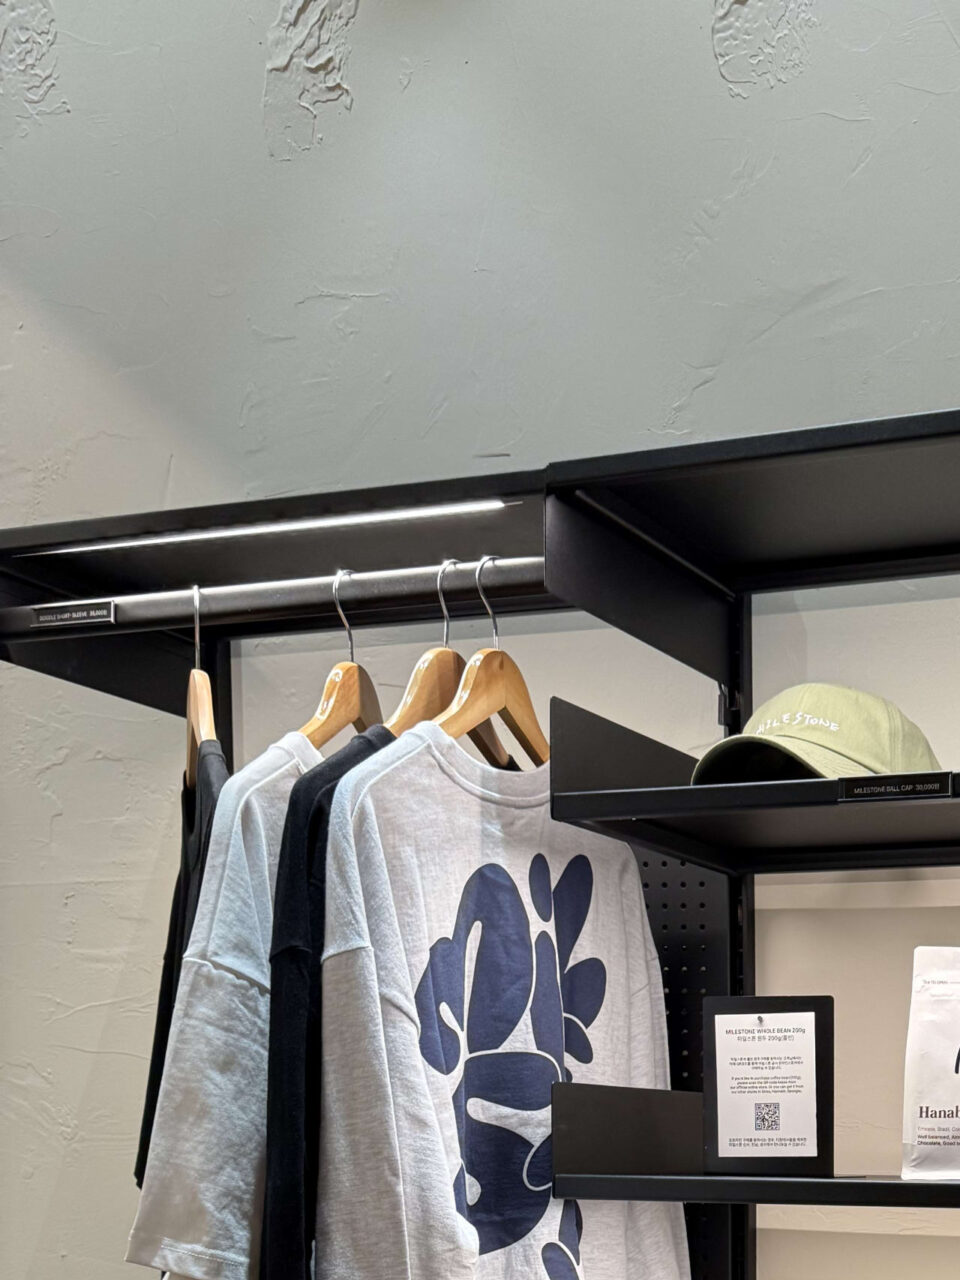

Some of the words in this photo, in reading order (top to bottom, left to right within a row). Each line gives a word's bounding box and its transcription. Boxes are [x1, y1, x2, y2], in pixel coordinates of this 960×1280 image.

[755, 711, 841, 736] MILESTONE
[853, 786, 886, 794] MILESTONE
[901, 784, 913, 792] CAP
[725, 1028, 756, 1036] MILESTONE
[792, 1027, 806, 1035] 200g
